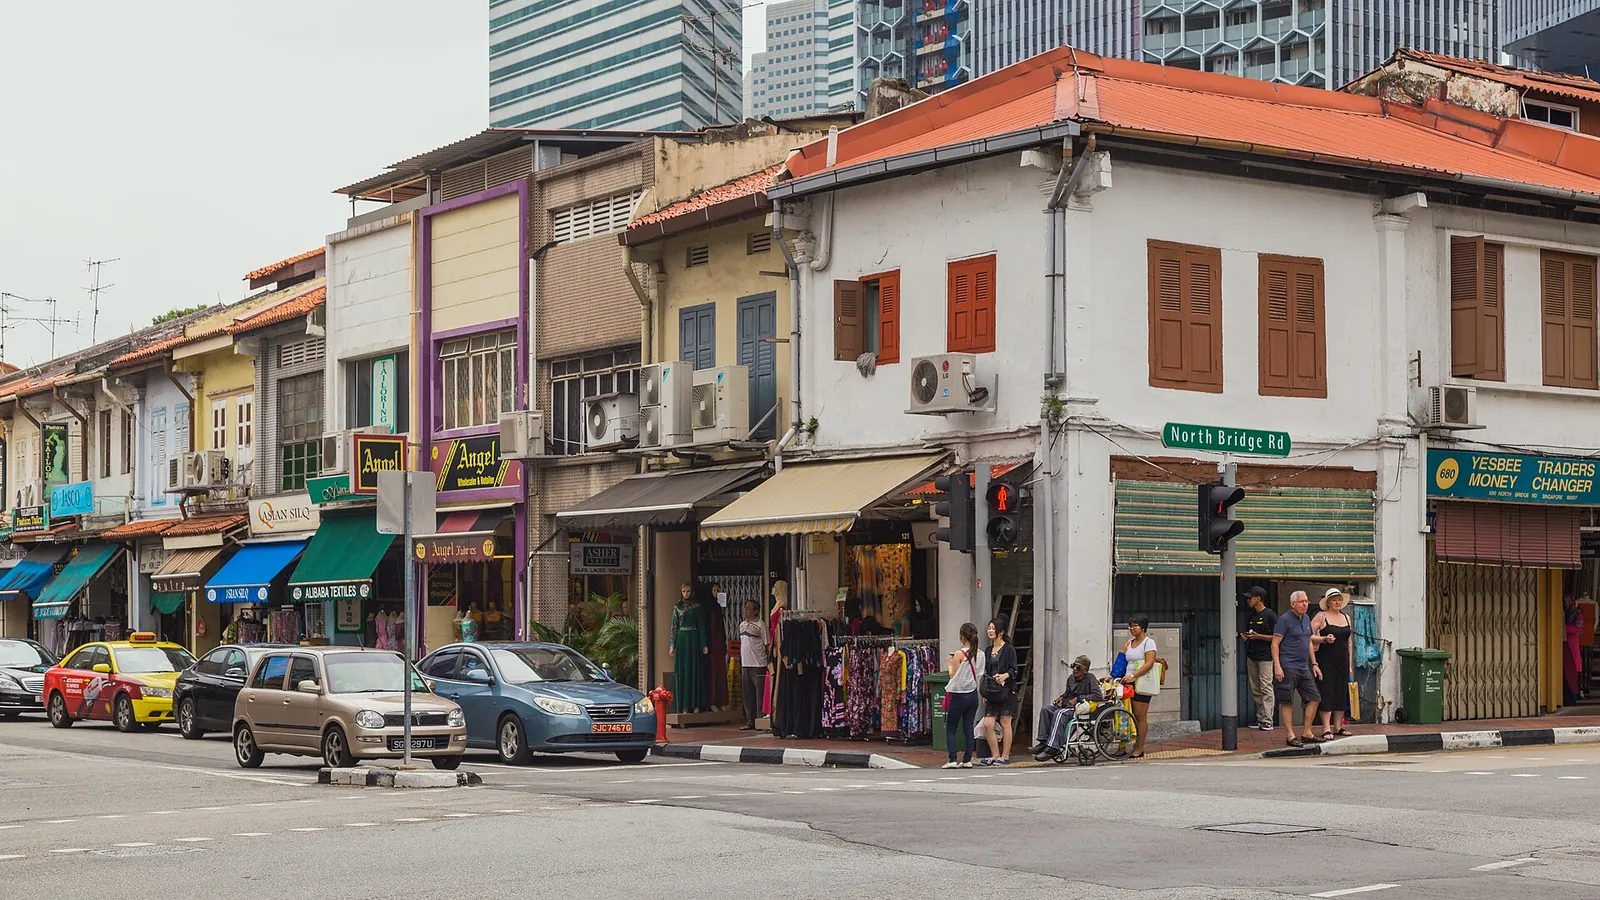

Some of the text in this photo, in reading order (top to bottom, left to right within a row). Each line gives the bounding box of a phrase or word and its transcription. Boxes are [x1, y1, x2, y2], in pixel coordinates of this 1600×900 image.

[1171, 426, 1284, 451] North Bridge Rd
[457, 440, 496, 474] Angel
[1440, 468, 1456, 479] 680
[1472, 456, 1596, 477] YESBEE TRADERS
[1468, 473, 1593, 493] MONEY CHANGER
[60, 487, 80, 507] JASCO
[262, 506, 310, 521] ASIAN SILQ
[432, 542, 477, 561] Angel Fabrics
[587, 548, 617, 557] ASHER
[158, 580, 185, 591] sutra
[305, 586, 328, 599] ALIBABA
[330, 585, 357, 598] TEXTILES
[393, 741, 433, 749] SG297U
